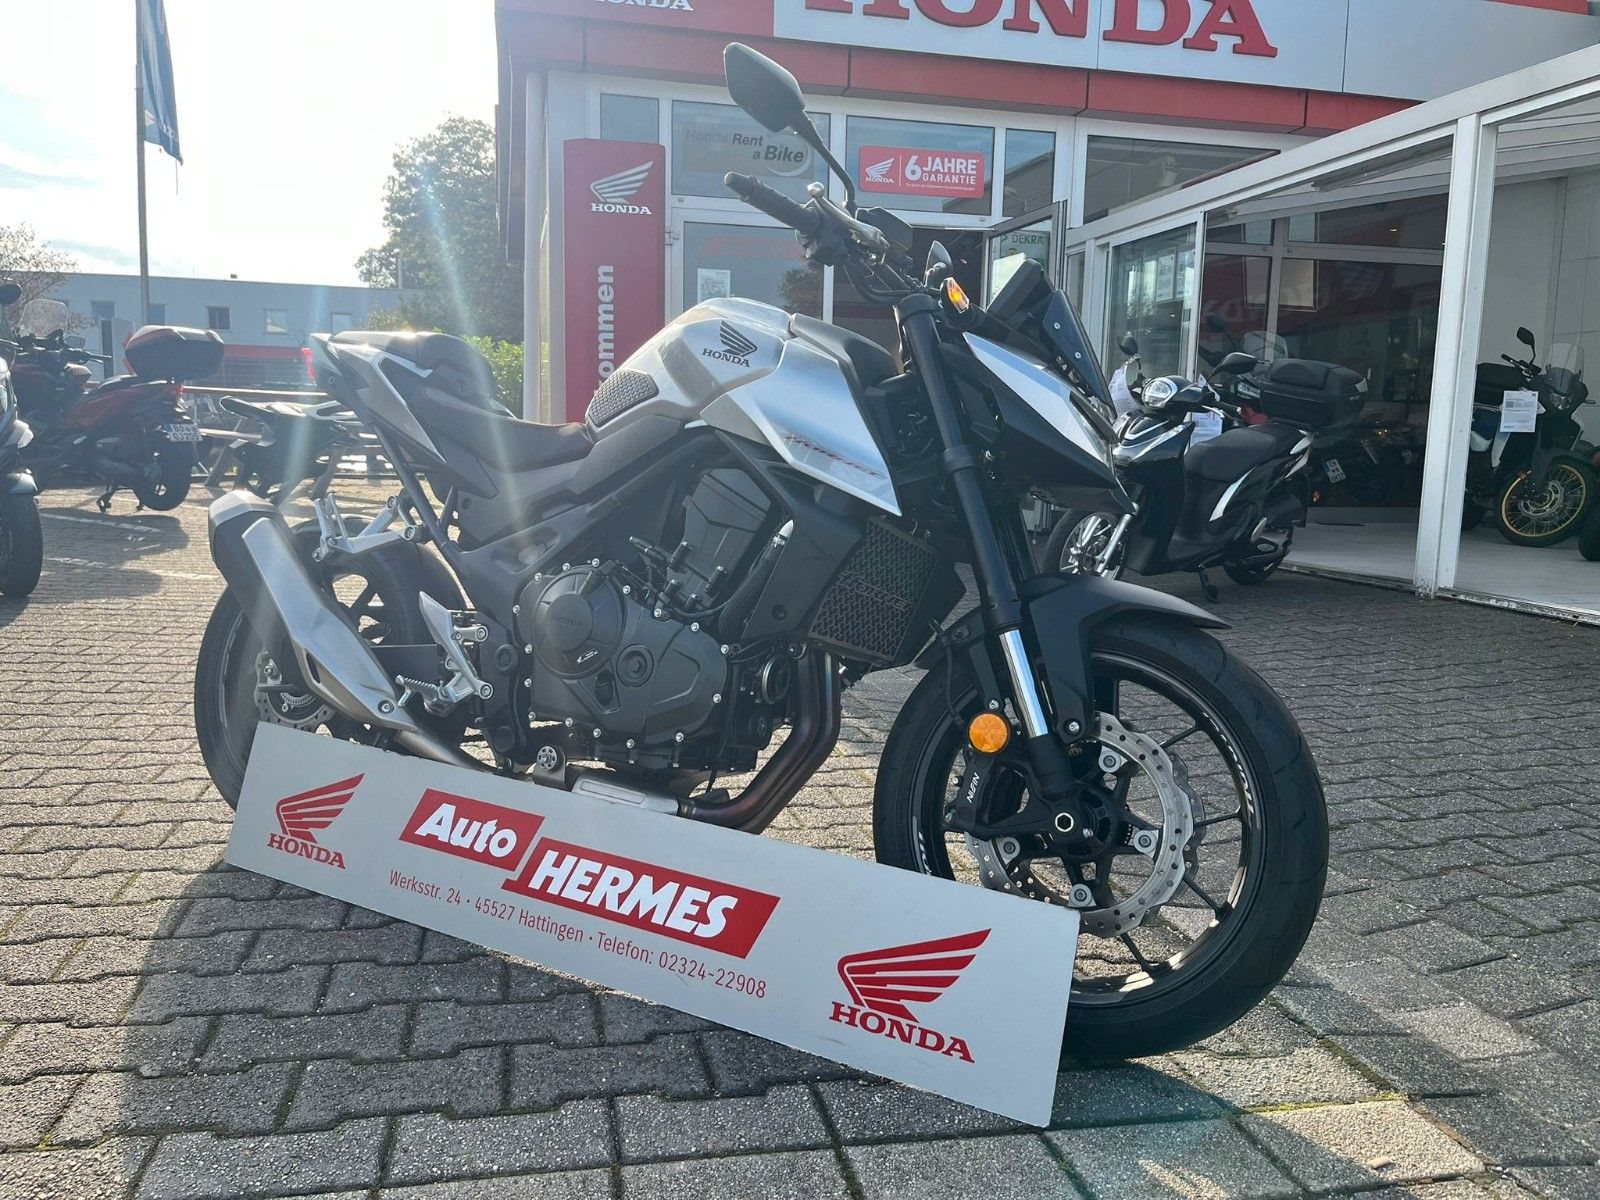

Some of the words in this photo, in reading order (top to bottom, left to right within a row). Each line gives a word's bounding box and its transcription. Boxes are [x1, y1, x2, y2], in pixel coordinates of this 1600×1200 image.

[732, 133, 763, 147] Rent
[753, 151, 760, 159] a
[764, 145, 804, 163] Bike
[904, 155, 922, 181] 6
[922, 156, 977, 175] JAHRE
[922, 172, 976, 185] GARANTIE
[590, 203, 652, 215] HONDA
[1012, 233, 1044, 245] DEKRA
[596, 264, 615, 388] ommen
[702, 348, 750, 368] HONDA
[415, 803, 518, 858] Auto
[267, 832, 346, 870] HONDA
[529, 849, 738, 938] HERMES
[389, 869, 444, 901] Werksstr.
[446, 886, 462, 906] 24
[475, 895, 516, 922] 45527
[519, 908, 584, 944] Hattingen
[597, 931, 655, 966] Telefon:
[658, 951, 768, 999] 02324-22908
[828, 1001, 976, 1065] HONDA
